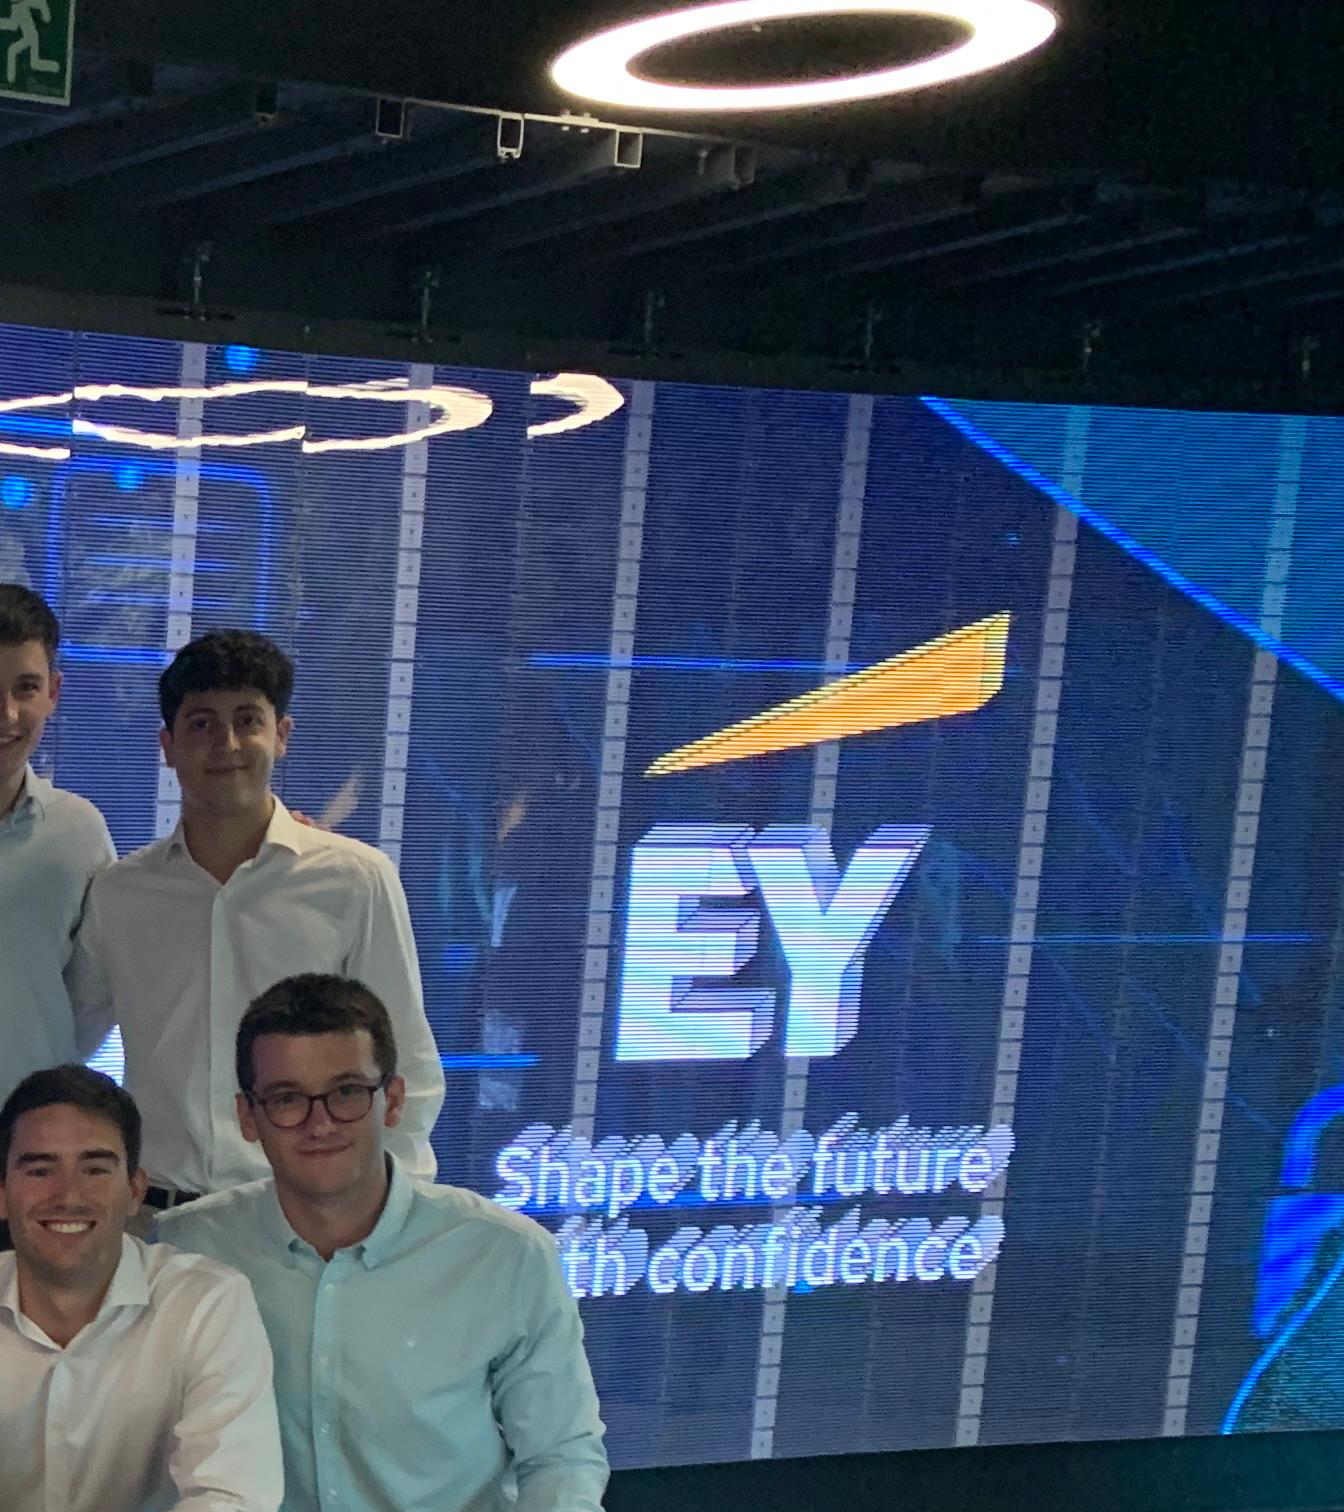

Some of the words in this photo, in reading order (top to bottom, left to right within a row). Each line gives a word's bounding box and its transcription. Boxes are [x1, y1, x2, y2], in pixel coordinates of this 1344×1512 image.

[614, 822, 934, 1058] EY
[493, 1125, 699, 1218] Shape
[696, 1119, 812, 1201] the
[812, 1113, 1013, 1196] future
[557, 1215, 648, 1297] th
[647, 1207, 1004, 1294] confidence
